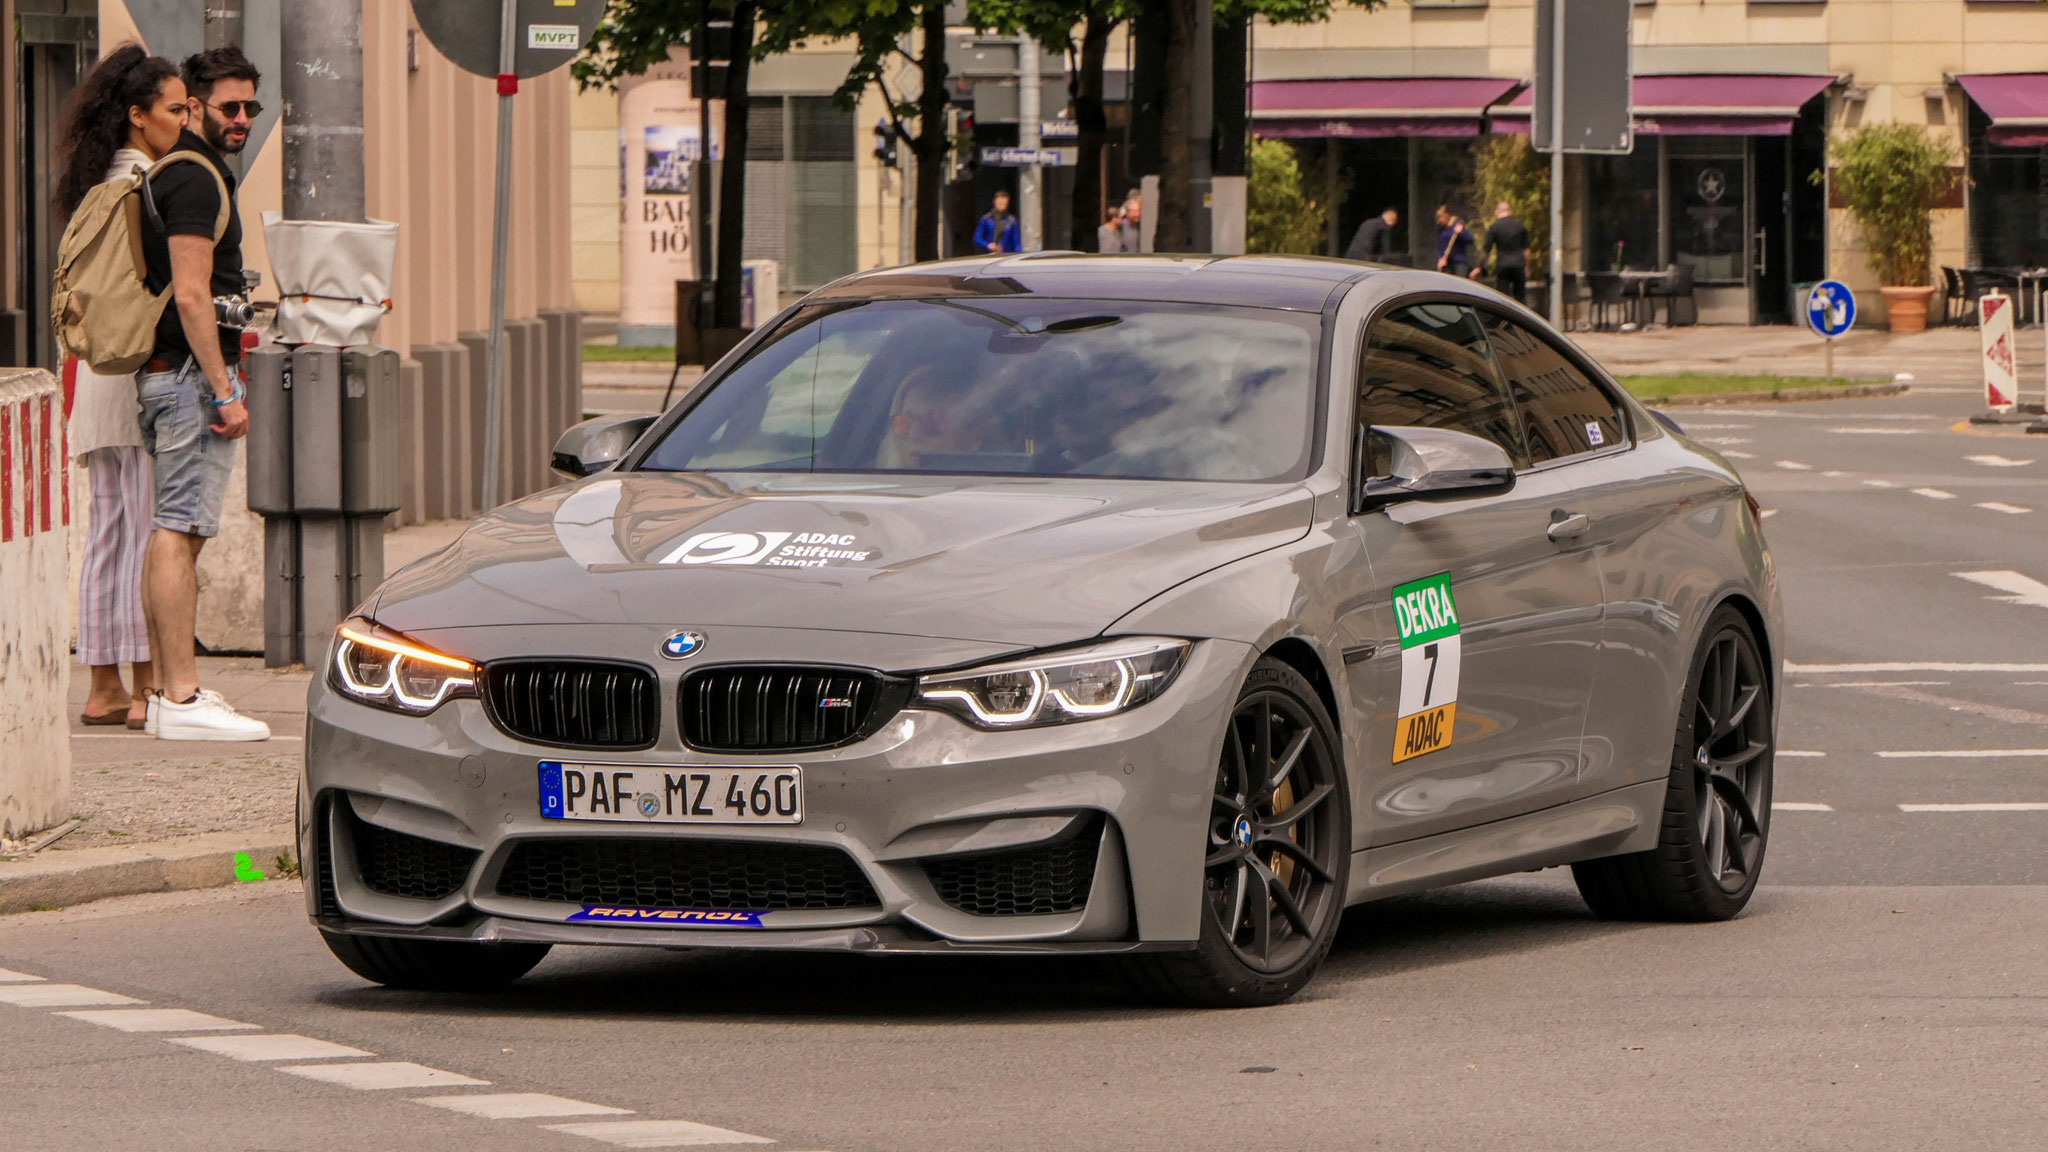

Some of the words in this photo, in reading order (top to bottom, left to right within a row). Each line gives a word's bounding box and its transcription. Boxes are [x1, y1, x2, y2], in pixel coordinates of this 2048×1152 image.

[535, 32, 577, 43] MVPT
[283, 372, 292, 390] 3
[792, 532, 855, 546] ADAC
[779, 545, 870, 562] Stiftung
[1395, 583, 1457, 638] DEKRA
[1423, 643, 1438, 707] 7
[1404, 709, 1444, 756] ADAC
[565, 770, 633, 813] PAF
[664, 773, 713, 815] MZ
[725, 774, 797, 816] 460
[548, 796, 557, 808] D
[588, 907, 751, 921] RAVENOL
